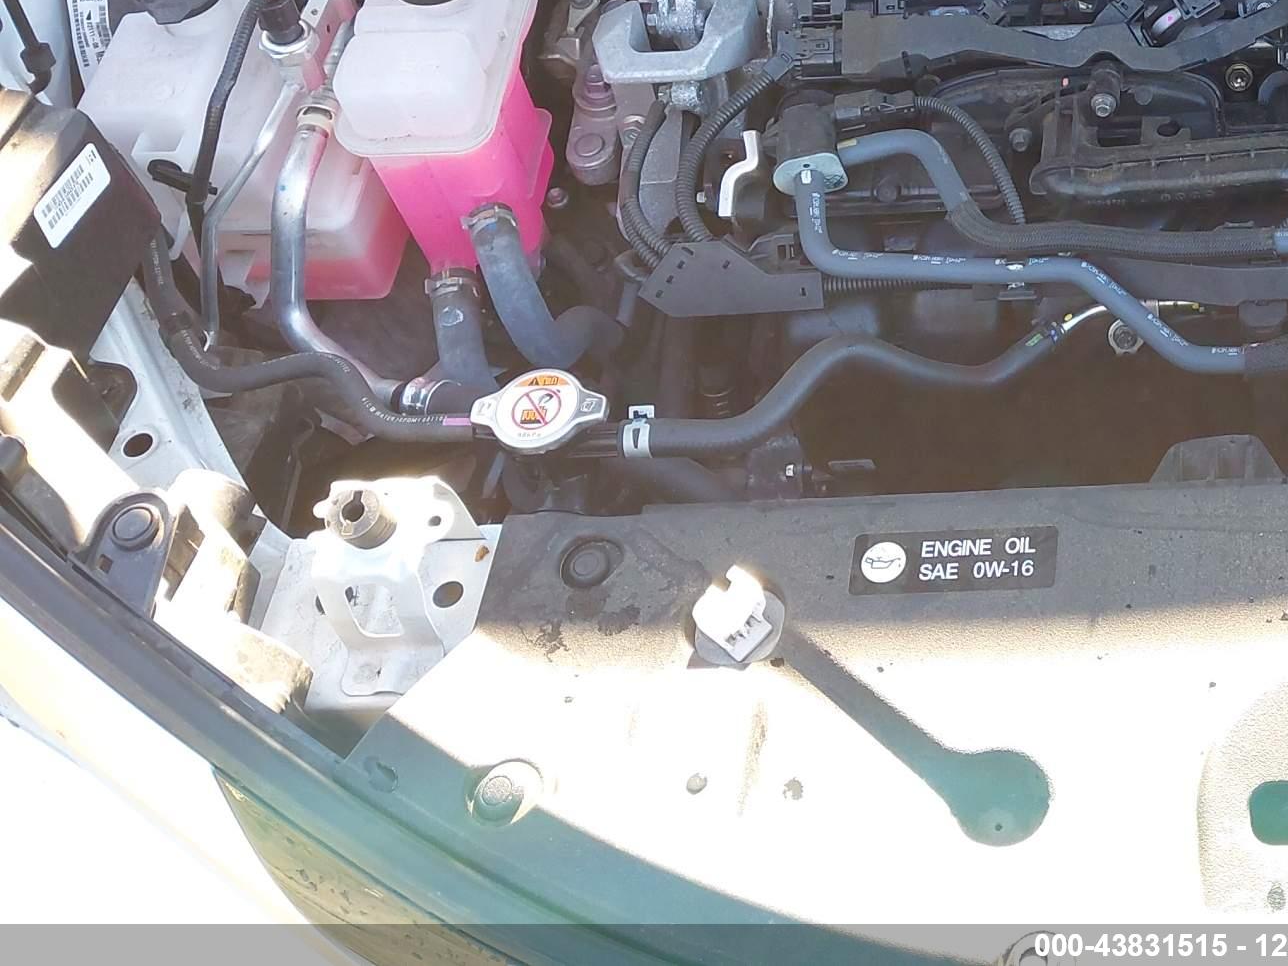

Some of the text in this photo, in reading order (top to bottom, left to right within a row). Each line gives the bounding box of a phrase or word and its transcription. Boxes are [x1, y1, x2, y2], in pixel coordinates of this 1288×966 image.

[920, 536, 1037, 558] ENGINE OIL
[918, 559, 1035, 582] SAE 0W-16
